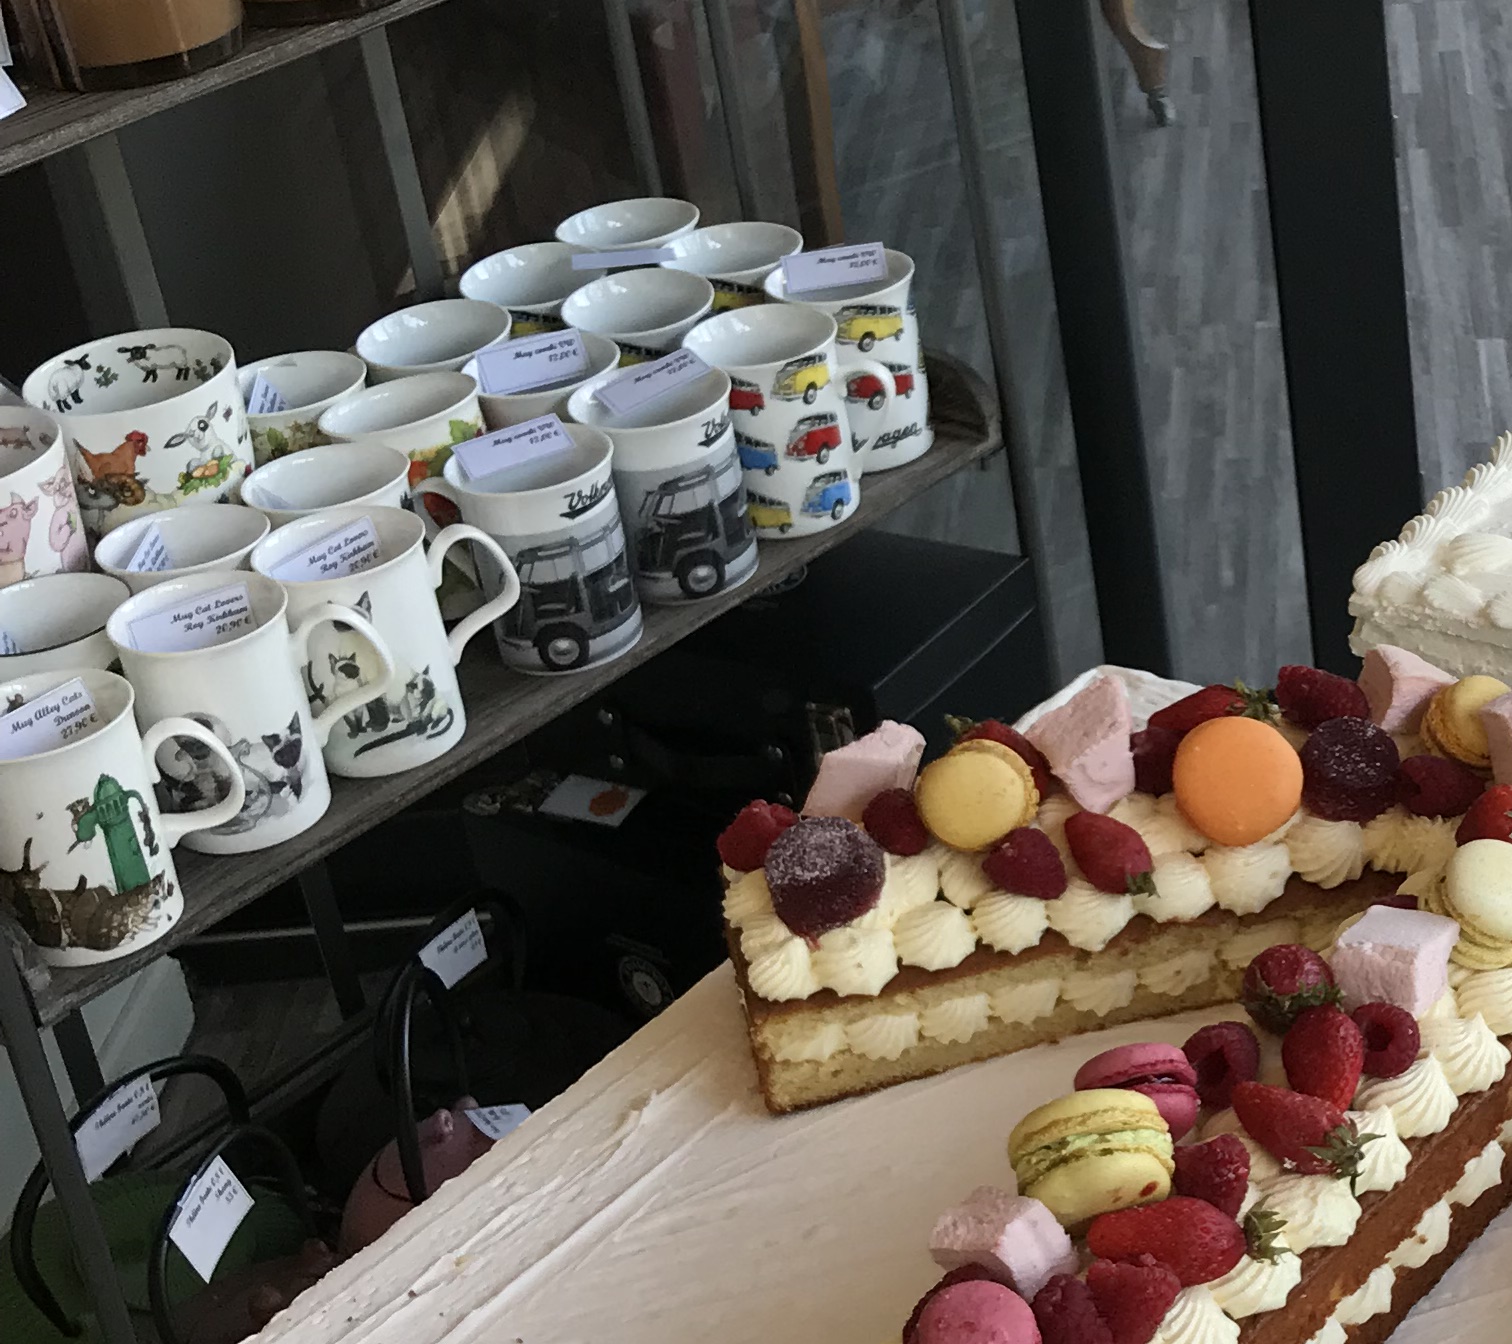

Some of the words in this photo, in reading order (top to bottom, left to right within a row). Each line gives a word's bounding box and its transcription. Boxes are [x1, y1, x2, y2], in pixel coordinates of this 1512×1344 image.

[307, 553, 328, 567] Mug
[170, 612, 193, 625] Mug
[194, 604, 211, 615] Cat
[214, 594, 244, 609] Lovers
[184, 621, 204, 632] Roy
[11, 718, 34, 734] Mug
[34, 703, 60, 721] Alley
[61, 692, 83, 706] Cats
